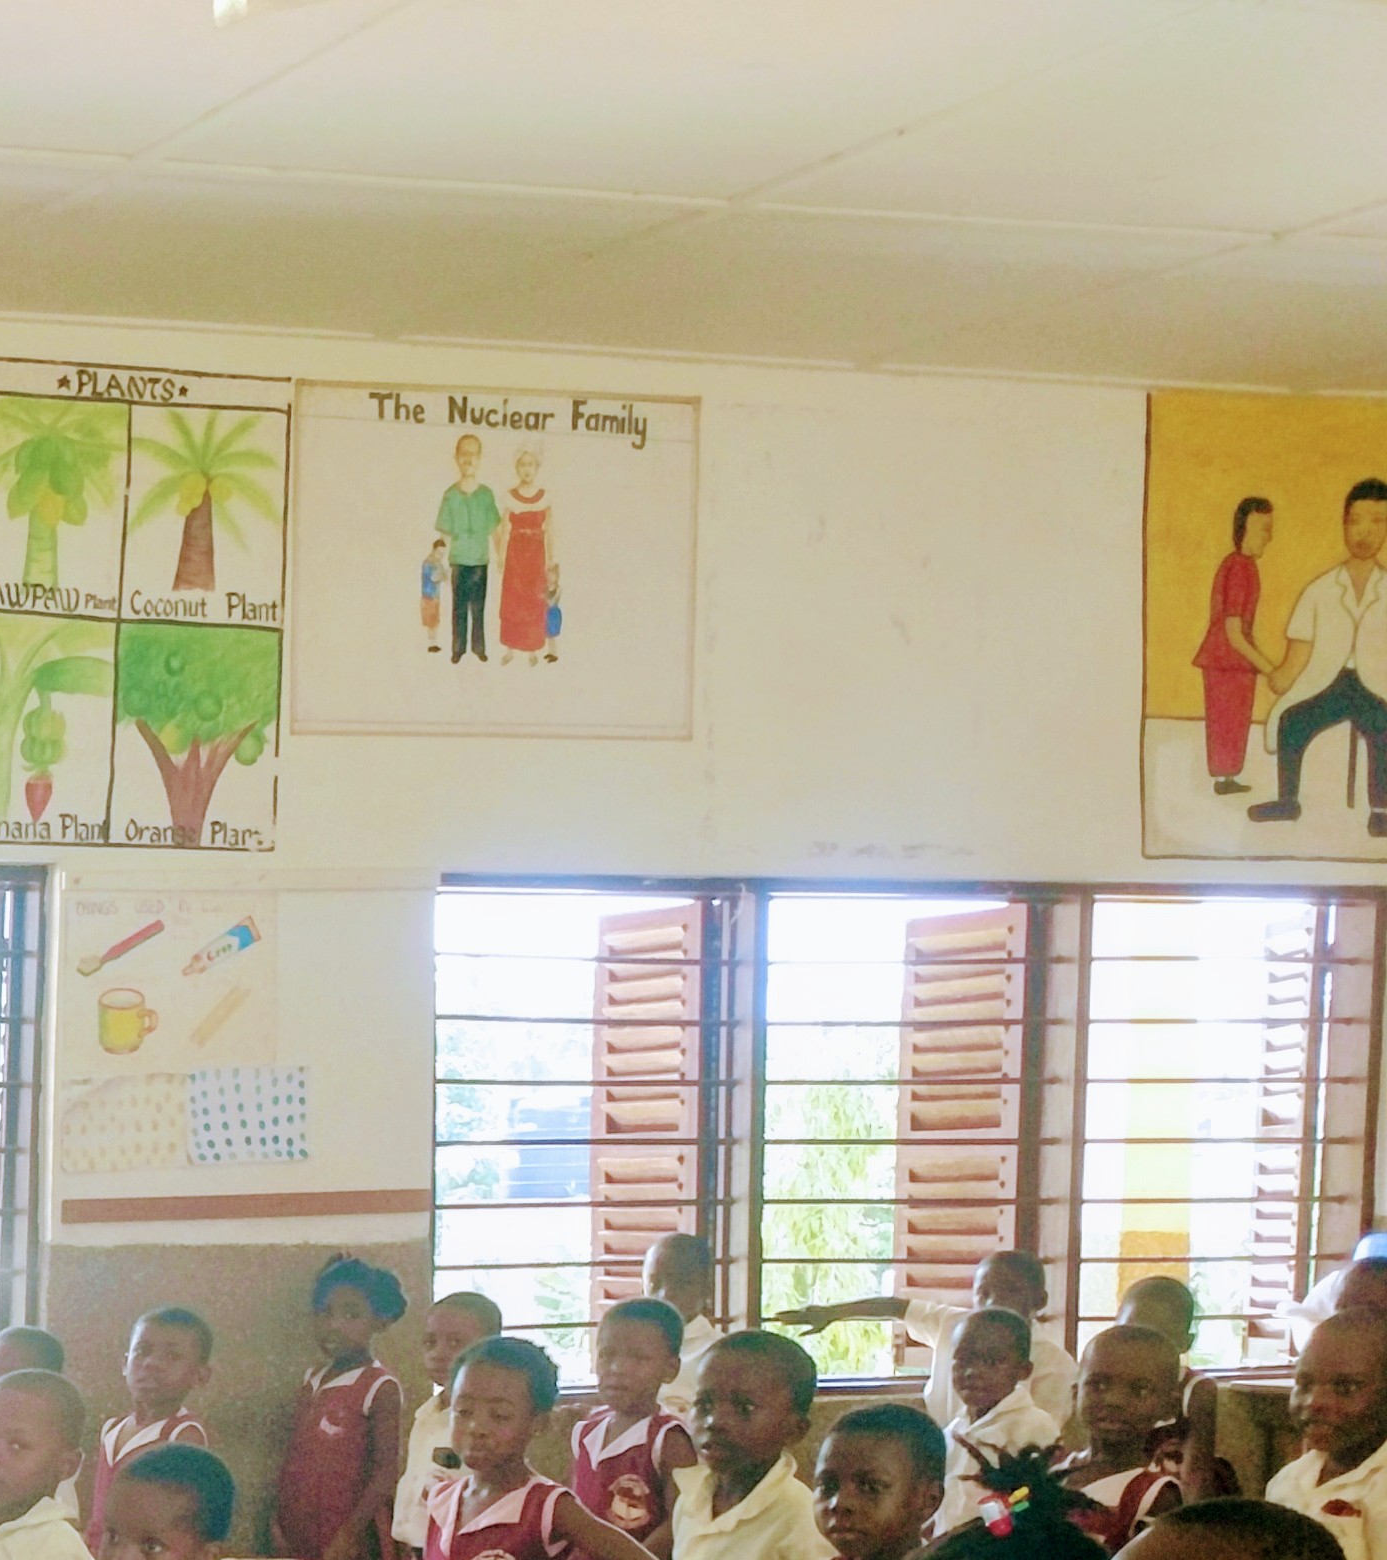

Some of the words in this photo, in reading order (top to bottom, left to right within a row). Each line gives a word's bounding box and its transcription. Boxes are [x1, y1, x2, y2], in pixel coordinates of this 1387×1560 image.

[75, 369, 176, 403] PLANTS
[369, 392, 426, 424] The
[571, 399, 648, 450] Family
[130, 590, 207, 618] Coconut
[226, 591, 278, 623] Plant
